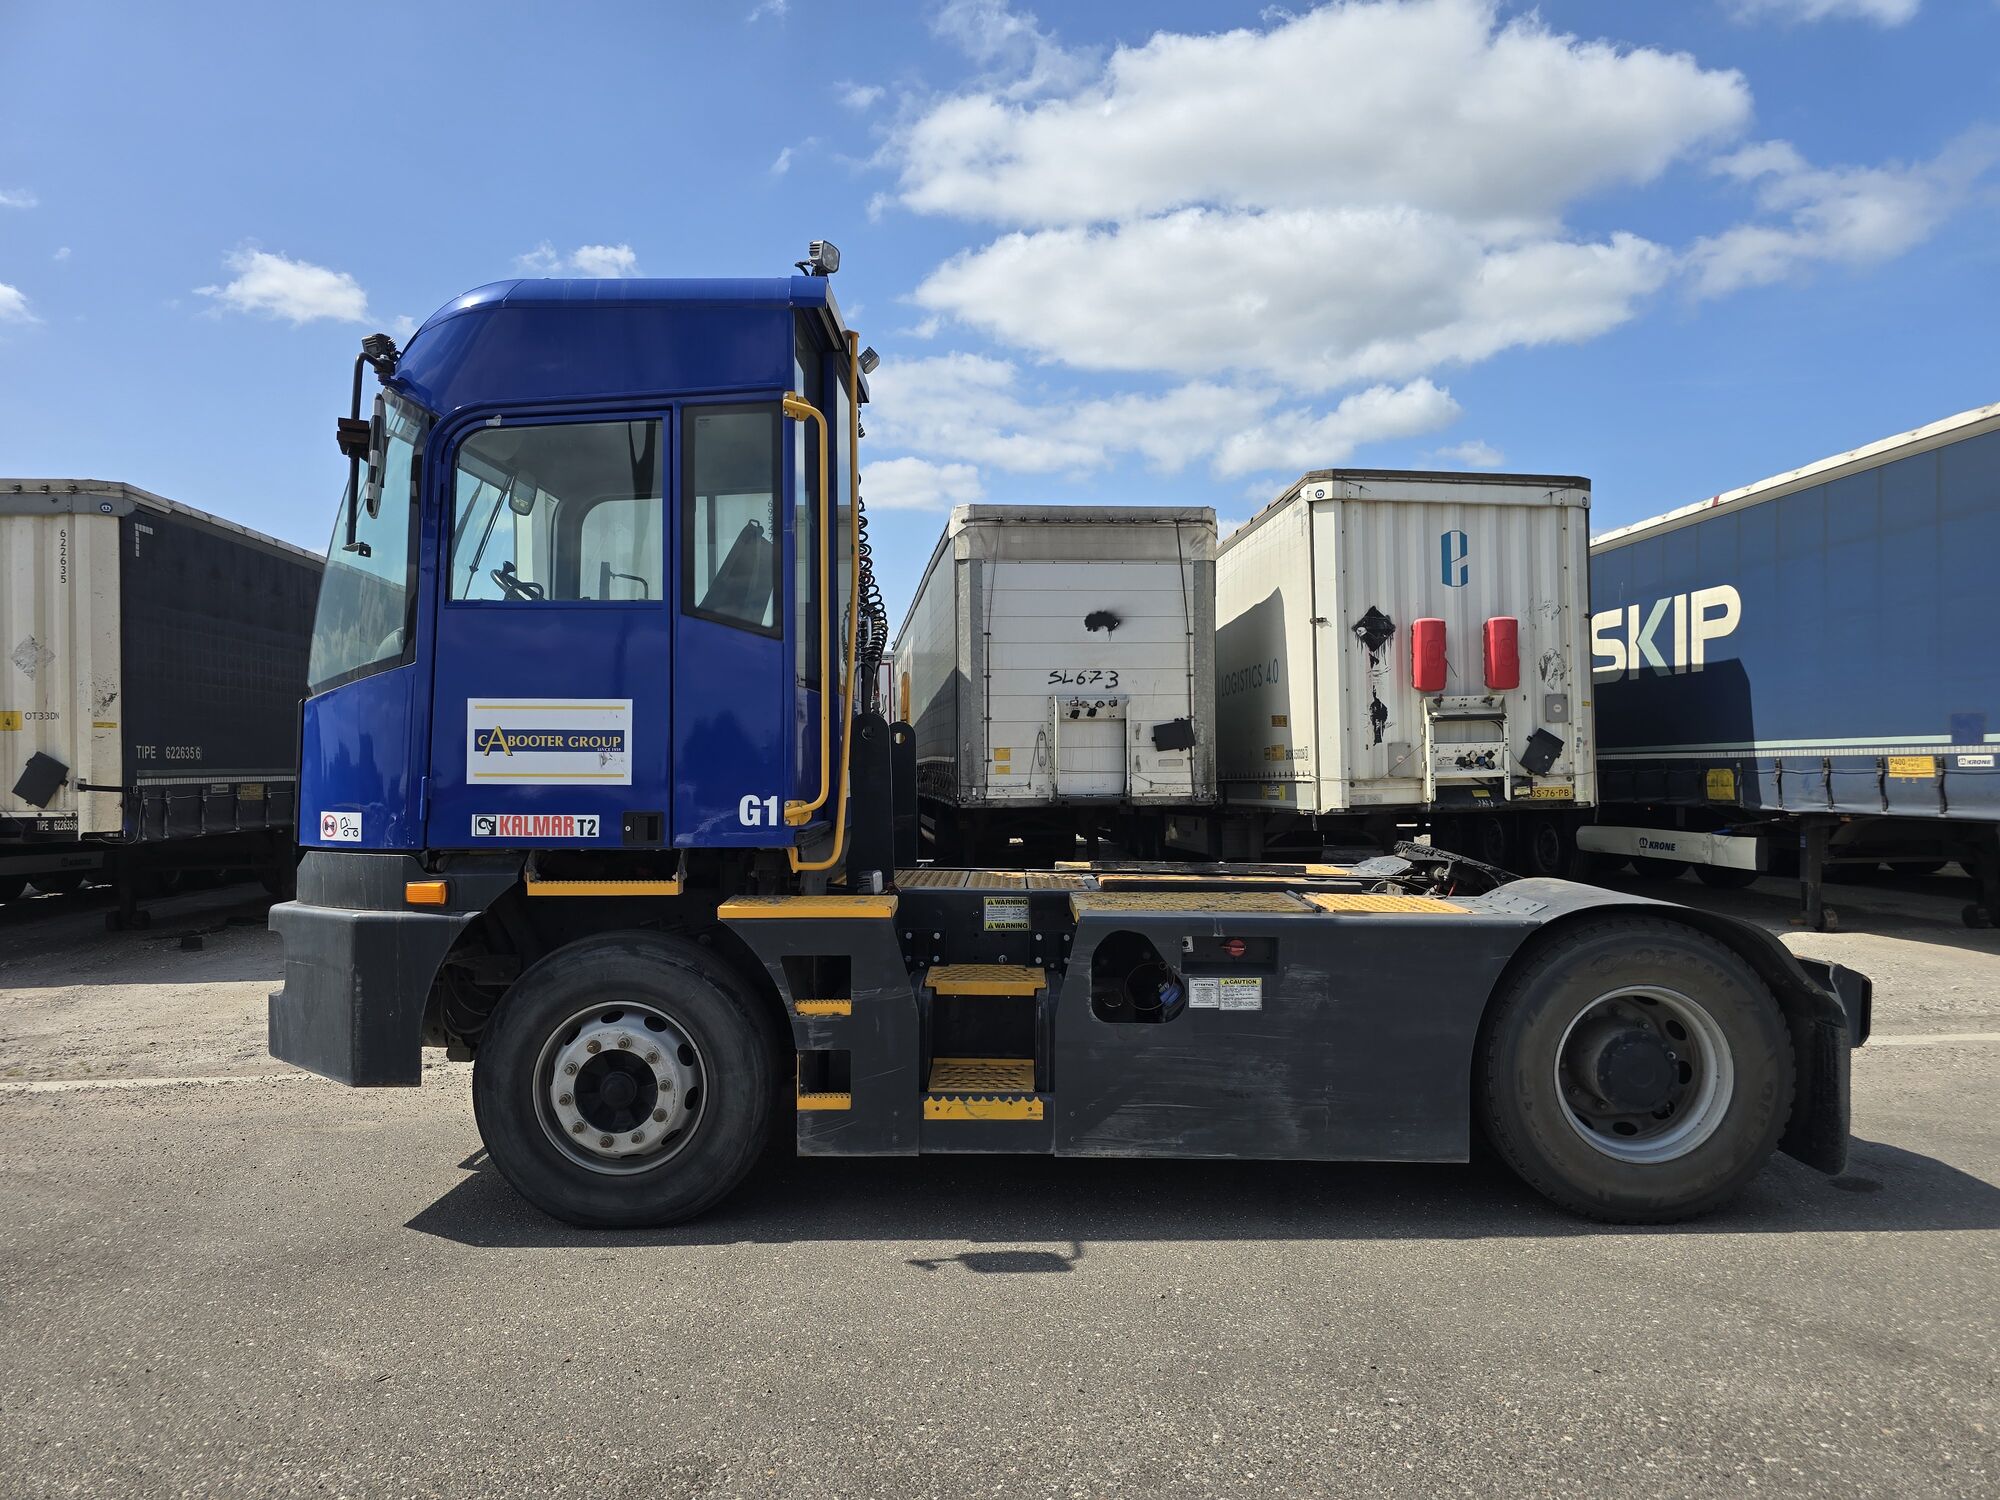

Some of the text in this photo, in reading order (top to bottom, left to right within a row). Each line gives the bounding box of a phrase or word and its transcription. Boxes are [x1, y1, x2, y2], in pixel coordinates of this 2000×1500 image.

[1592, 584, 1742, 685] SKIP
[1048, 669, 1119, 689] SL673
[1221, 657, 1279, 697] LOGISTICS 4.0
[477, 725, 622, 757] CABOOTER GROUP
[136, 745, 157, 760] TIPE
[738, 794, 778, 827] G1
[36, 820, 49, 831] TIPE
[499, 815, 597, 837] KALMAR T2
[1648, 840, 1676, 852] KRONE
